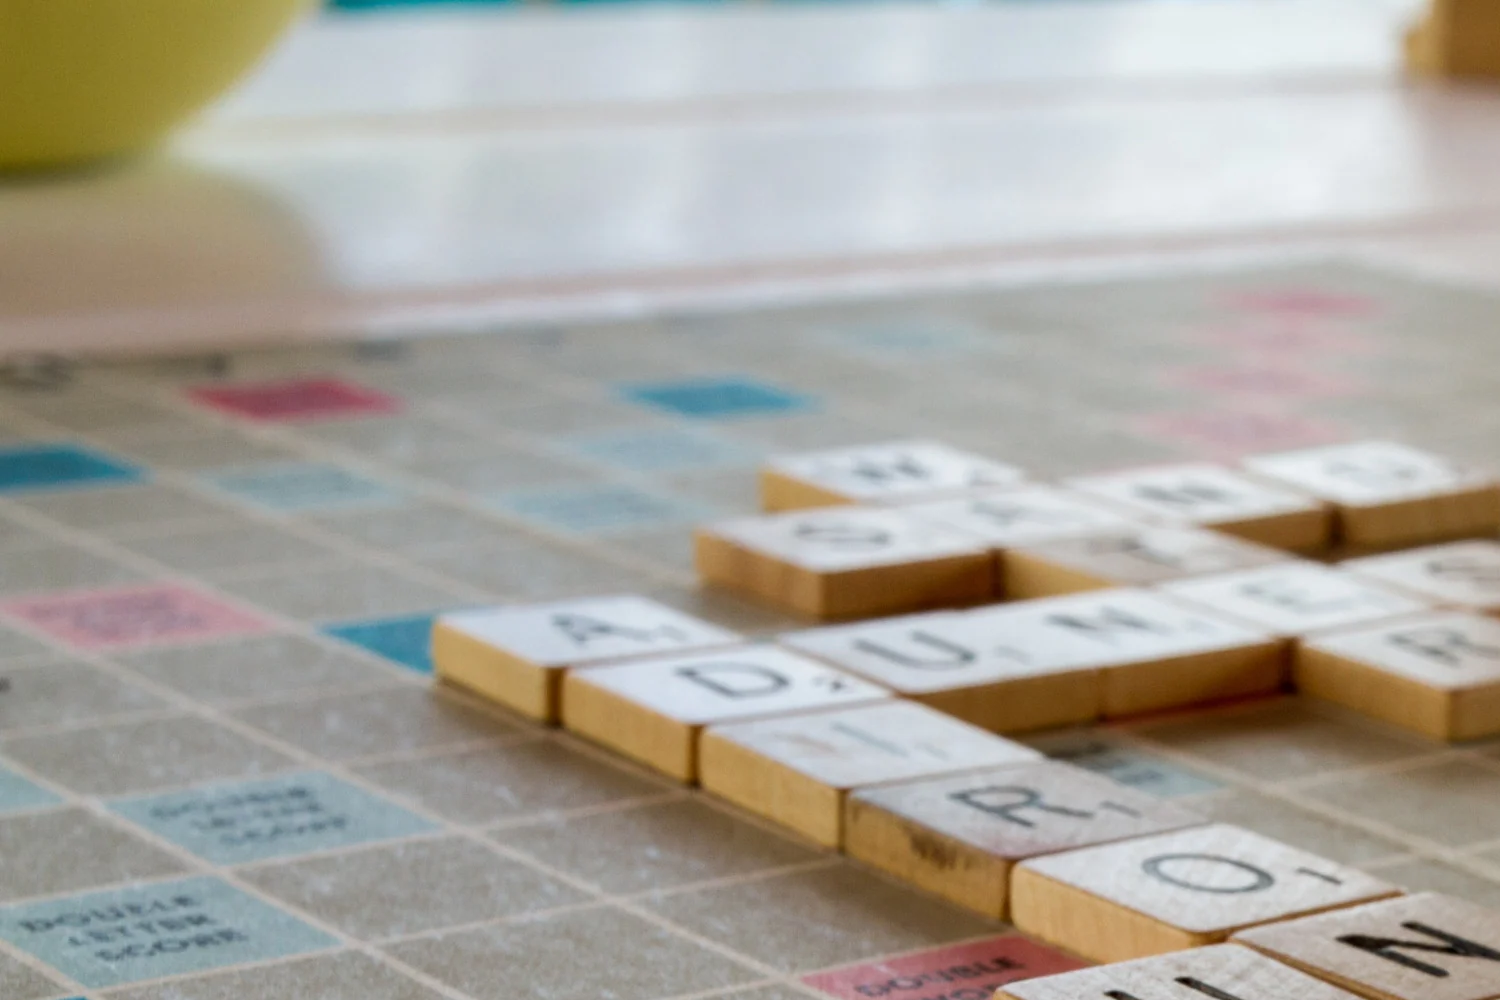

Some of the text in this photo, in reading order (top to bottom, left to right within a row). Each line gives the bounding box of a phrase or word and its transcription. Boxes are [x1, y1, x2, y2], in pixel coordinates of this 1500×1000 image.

[852, 630, 978, 669] U
[674, 662, 791, 698] D
[946, 784, 1096, 829] R
[1141, 852, 1276, 894] O
